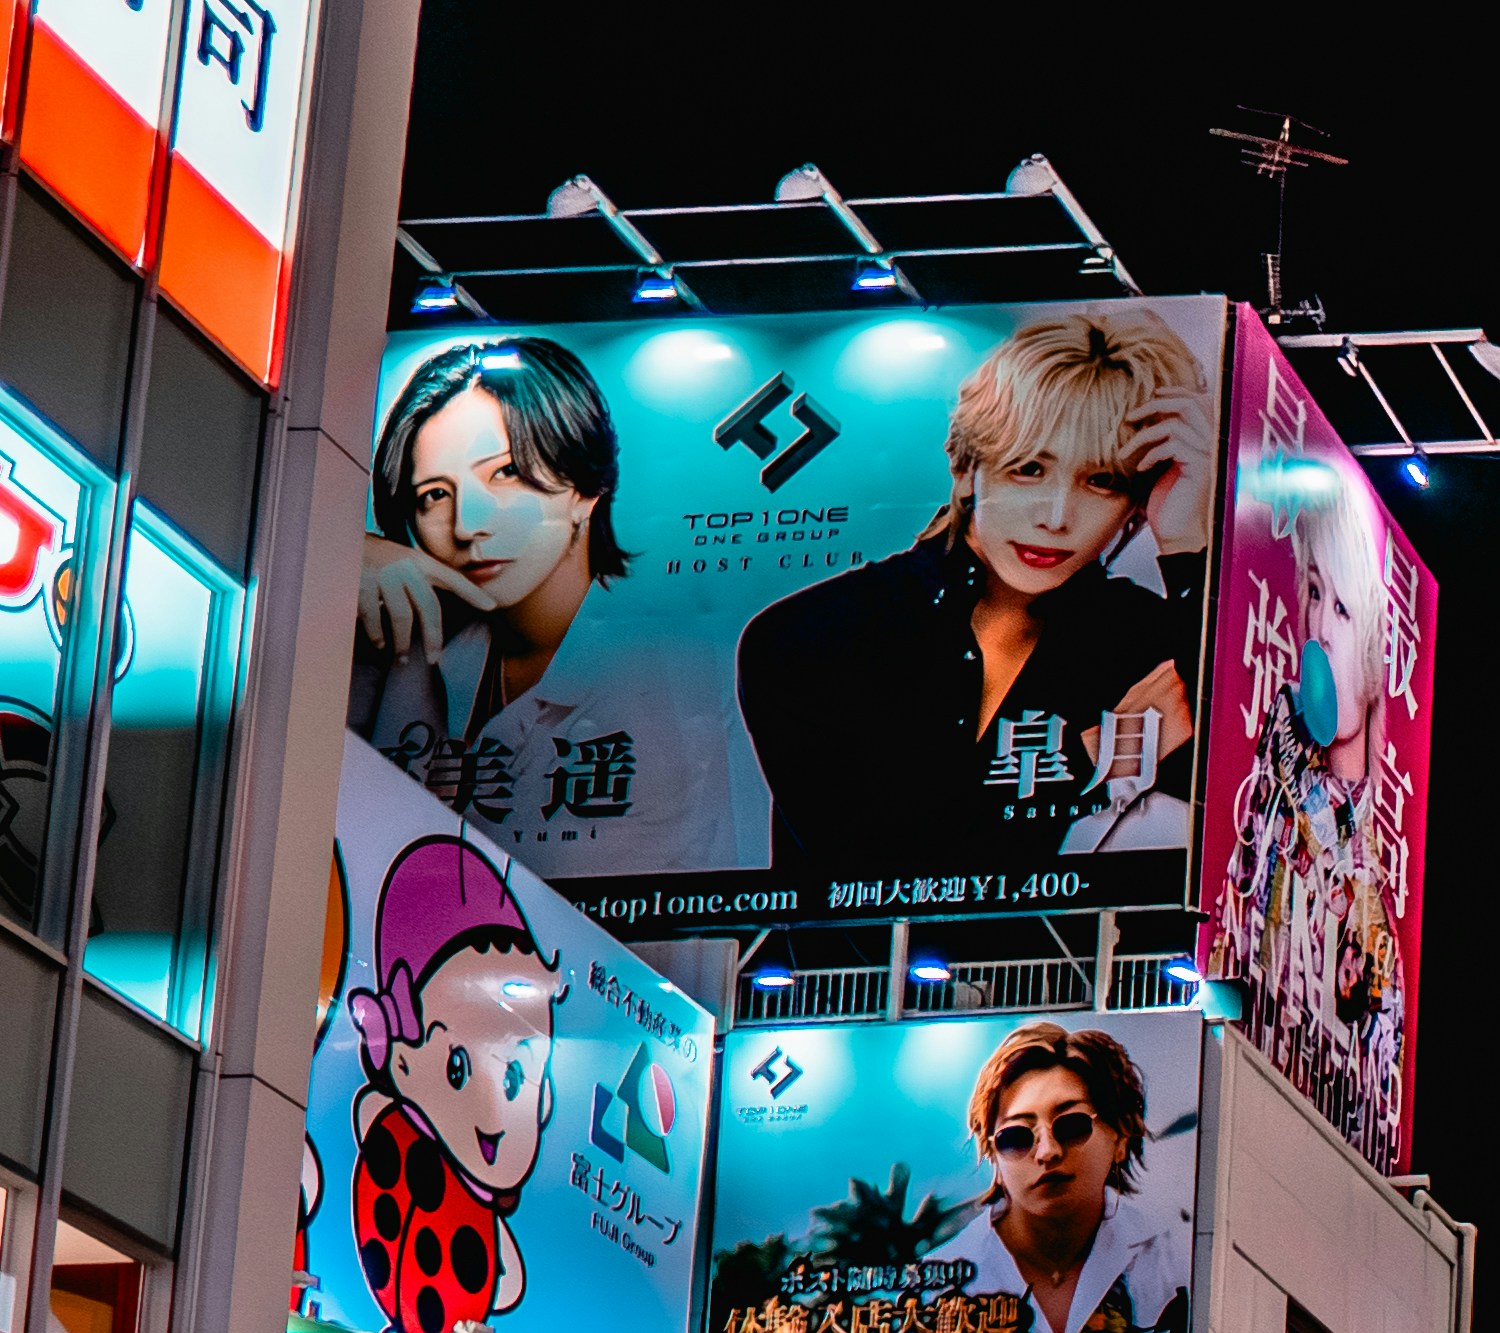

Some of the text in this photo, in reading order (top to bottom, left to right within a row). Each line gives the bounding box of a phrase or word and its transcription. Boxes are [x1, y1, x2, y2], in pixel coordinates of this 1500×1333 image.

[665, 549, 866, 577] HOST CLUB
[570, 1152, 684, 1246] 富士グループ
